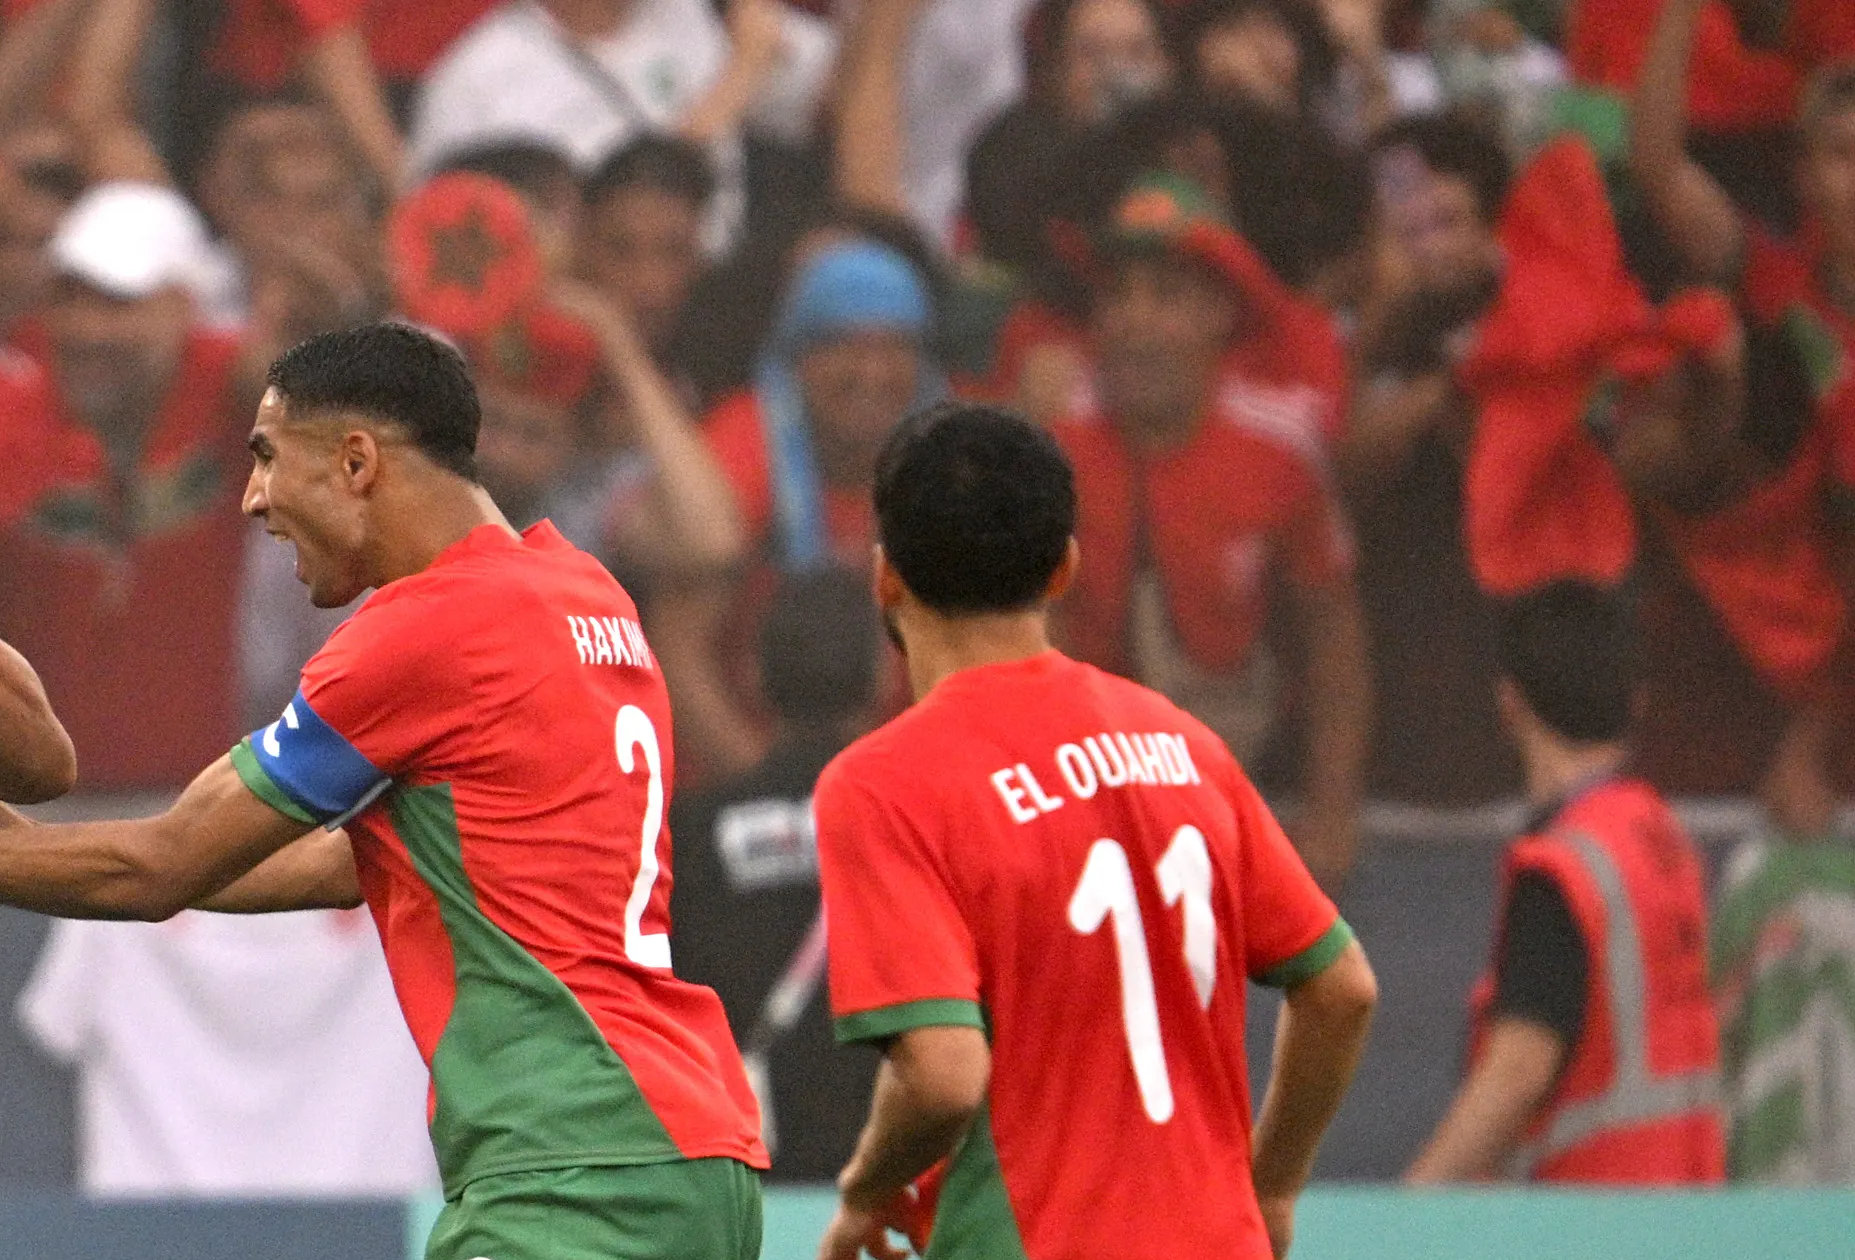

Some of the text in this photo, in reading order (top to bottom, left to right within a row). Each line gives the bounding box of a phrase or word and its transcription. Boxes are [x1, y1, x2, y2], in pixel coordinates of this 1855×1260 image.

[614, 704, 673, 969] 2
[991, 731, 1202, 823] EL OUAHDI
[1068, 824, 1216, 1124] 11
